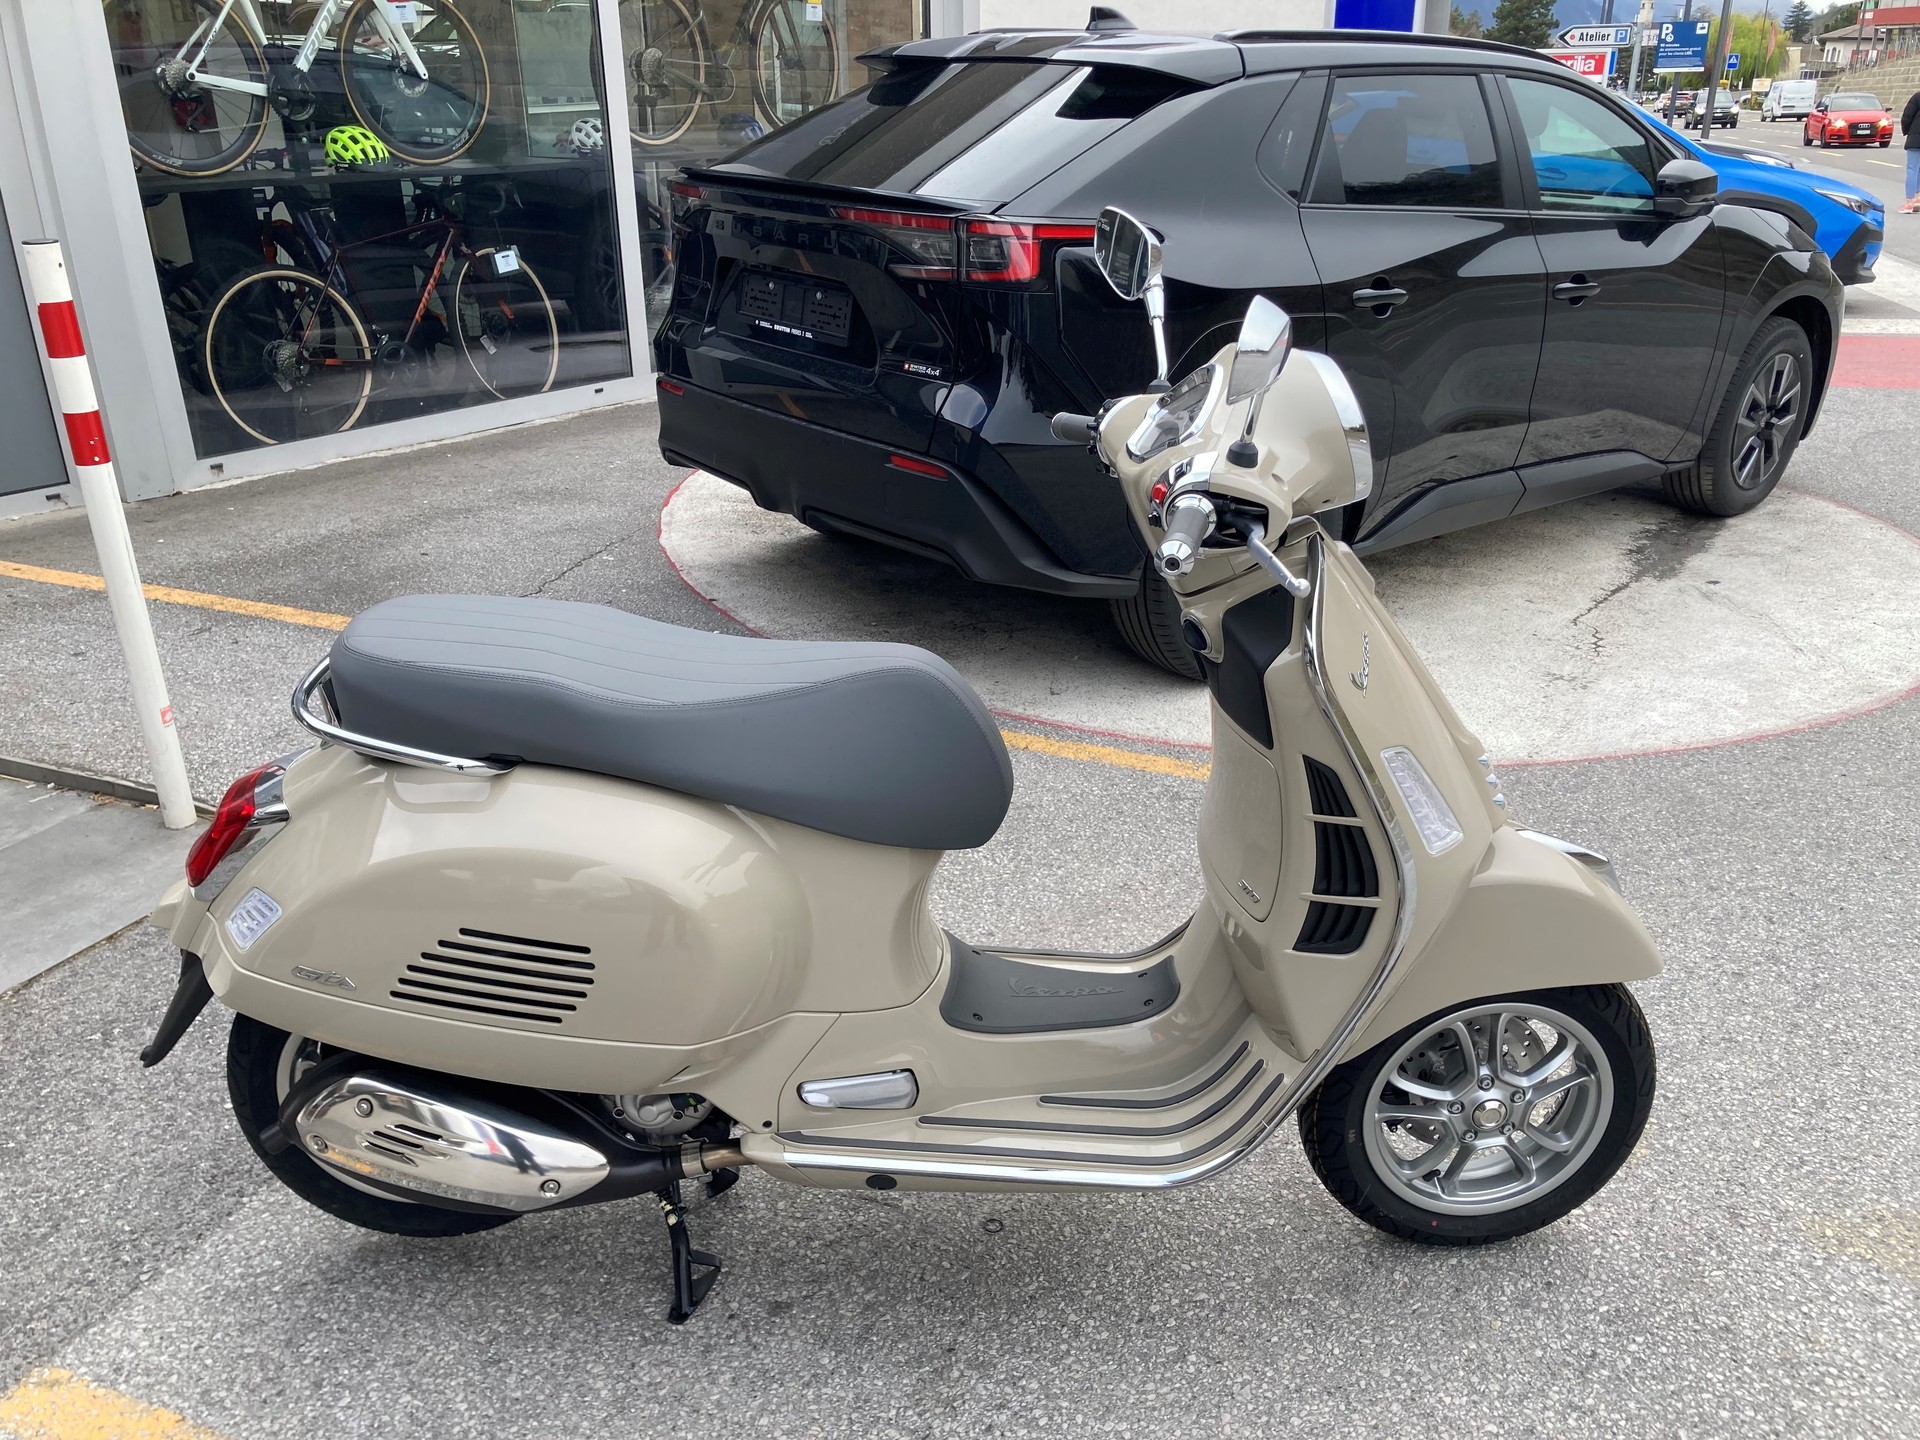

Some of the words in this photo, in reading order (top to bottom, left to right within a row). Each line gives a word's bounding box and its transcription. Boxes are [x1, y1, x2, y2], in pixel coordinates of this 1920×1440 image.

[1578, 31, 1611, 42] Atelier
[715, 219, 836, 249] SUBARU
[926, 367, 940, 377] 4x4
[1007, 976, 1124, 999] Vespa
